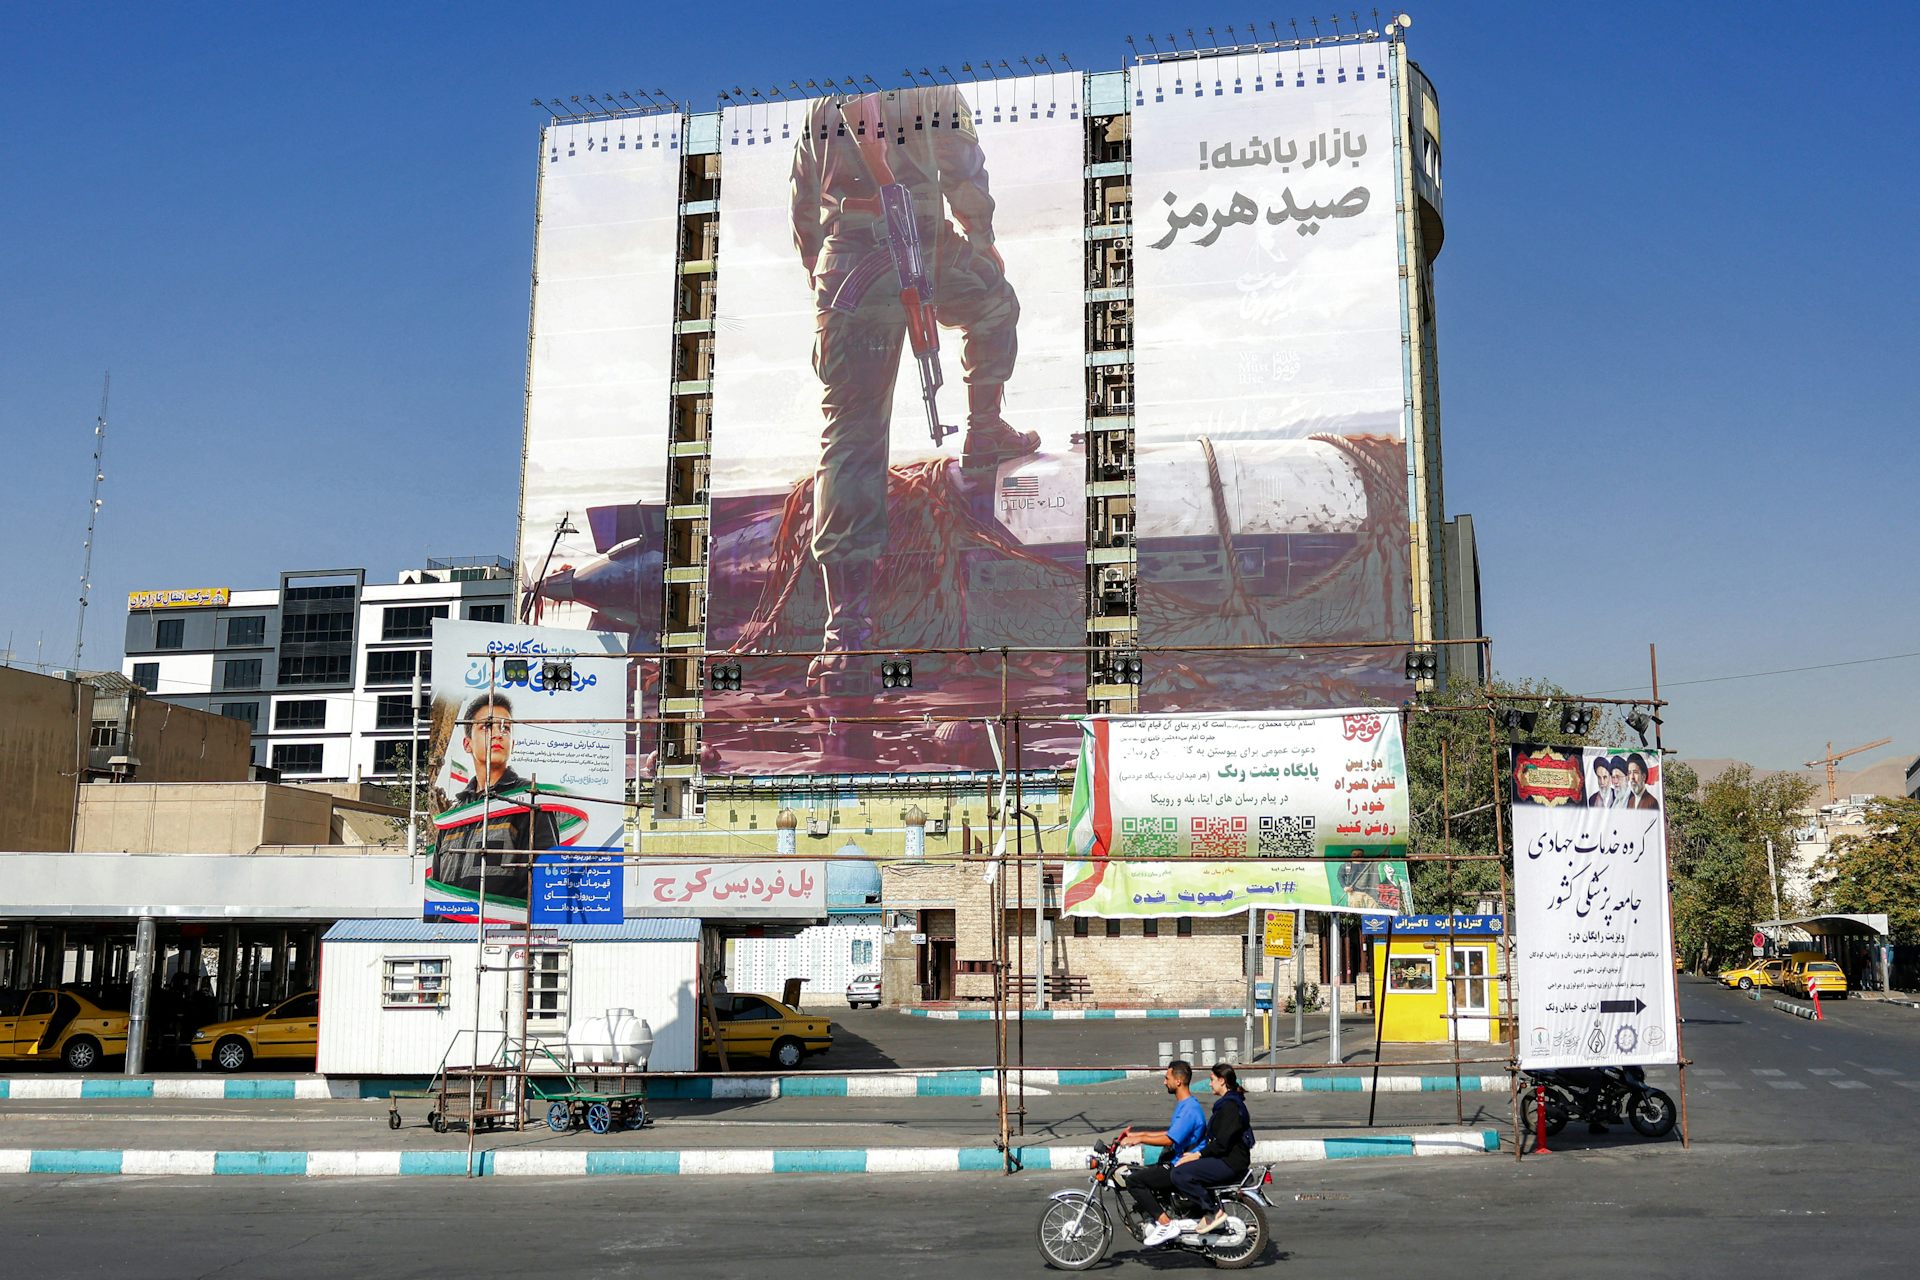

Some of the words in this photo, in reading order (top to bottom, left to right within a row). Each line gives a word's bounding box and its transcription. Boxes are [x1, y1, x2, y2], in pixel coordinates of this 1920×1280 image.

[1200, 136, 1297, 173] باشه!
[1302, 128, 1367, 169] بازار
[1266, 186, 1370, 237] صید
[1146, 191, 1258, 250] هرمز
[130, 594, 150, 605] ایران
[163, 591, 185, 604] انتقال
[188, 591, 210, 605] شرکت
[487, 640, 515, 654] مردم
[1148, 721, 1161, 732] قیام
[1174, 721, 1189, 731] بنای
[1191, 721, 1200, 730] زیر
[1298, 720, 1315, 730] اسلام
[547, 740, 573, 749] موسوی
[574, 741, 596, 750] کیارش
[596, 742, 610, 750] سید
[1207, 748, 1237, 757] پیوستن
[1240, 747, 1258, 758] برای
[1262, 748, 1288, 757] عمومی
[1291, 747, 1315, 756] دعوت
[1346, 759, 1383, 772] دوربین
[1250, 763, 1279, 781] بعثت
[1283, 762, 1319, 782] پایگاه
[1334, 776, 1368, 793] همراه
[1372, 776, 1396, 793] تلفن
[1150, 793, 1175, 806] روبیکا
[1177, 797, 1182, 806] و
[1184, 793, 1195, 805] بله
[1199, 793, 1213, 805] ایتا،
[1215, 793, 1232, 806] های
[1235, 793, 1258, 806] رسان
[1260, 793, 1276, 805] پیام
[1280, 794, 1289, 805] در
[1347, 798, 1358, 814] را
[1362, 798, 1385, 814] خود
[1336, 820, 1361, 836] کنید
[1365, 820, 1396, 836] روشن
[1574, 829, 1620, 854] خدمات
[1622, 818, 1657, 863] گروه
[1528, 830, 1573, 867] جهادی
[560, 866, 587, 875] ایران
[587, 868, 611, 877] مردم
[545, 878, 573, 888] واقعی
[574, 878, 611, 888] قهرمانان
[653, 867, 712, 902] کرج
[713, 869, 785, 902] فردیس
[788, 868, 814, 899] پل
[1547, 862, 1592, 910] کشور
[589, 891, 611, 901] این
[1577, 864, 1612, 926] پزشکی
[447, 905, 460, 913] دولت
[585, 904, 611, 912] سخت
[1613, 889, 1641, 924] جامعه
[1395, 918, 1428, 929] تاکسیرانی
[1457, 921, 1462, 929] و
[1463, 918, 1482, 929] کنترل
[1569, 932, 1580, 943] در:
[1582, 931, 1603, 943] رایگان
[1606, 932, 1624, 943] ویزیت
[1529, 951, 1544, 959] کودکان
[1545, 1003, 1559, 1014] ونک
[1560, 1002, 1578, 1013] خیابان
[1581, 1003, 1599, 1013] ابتدای
